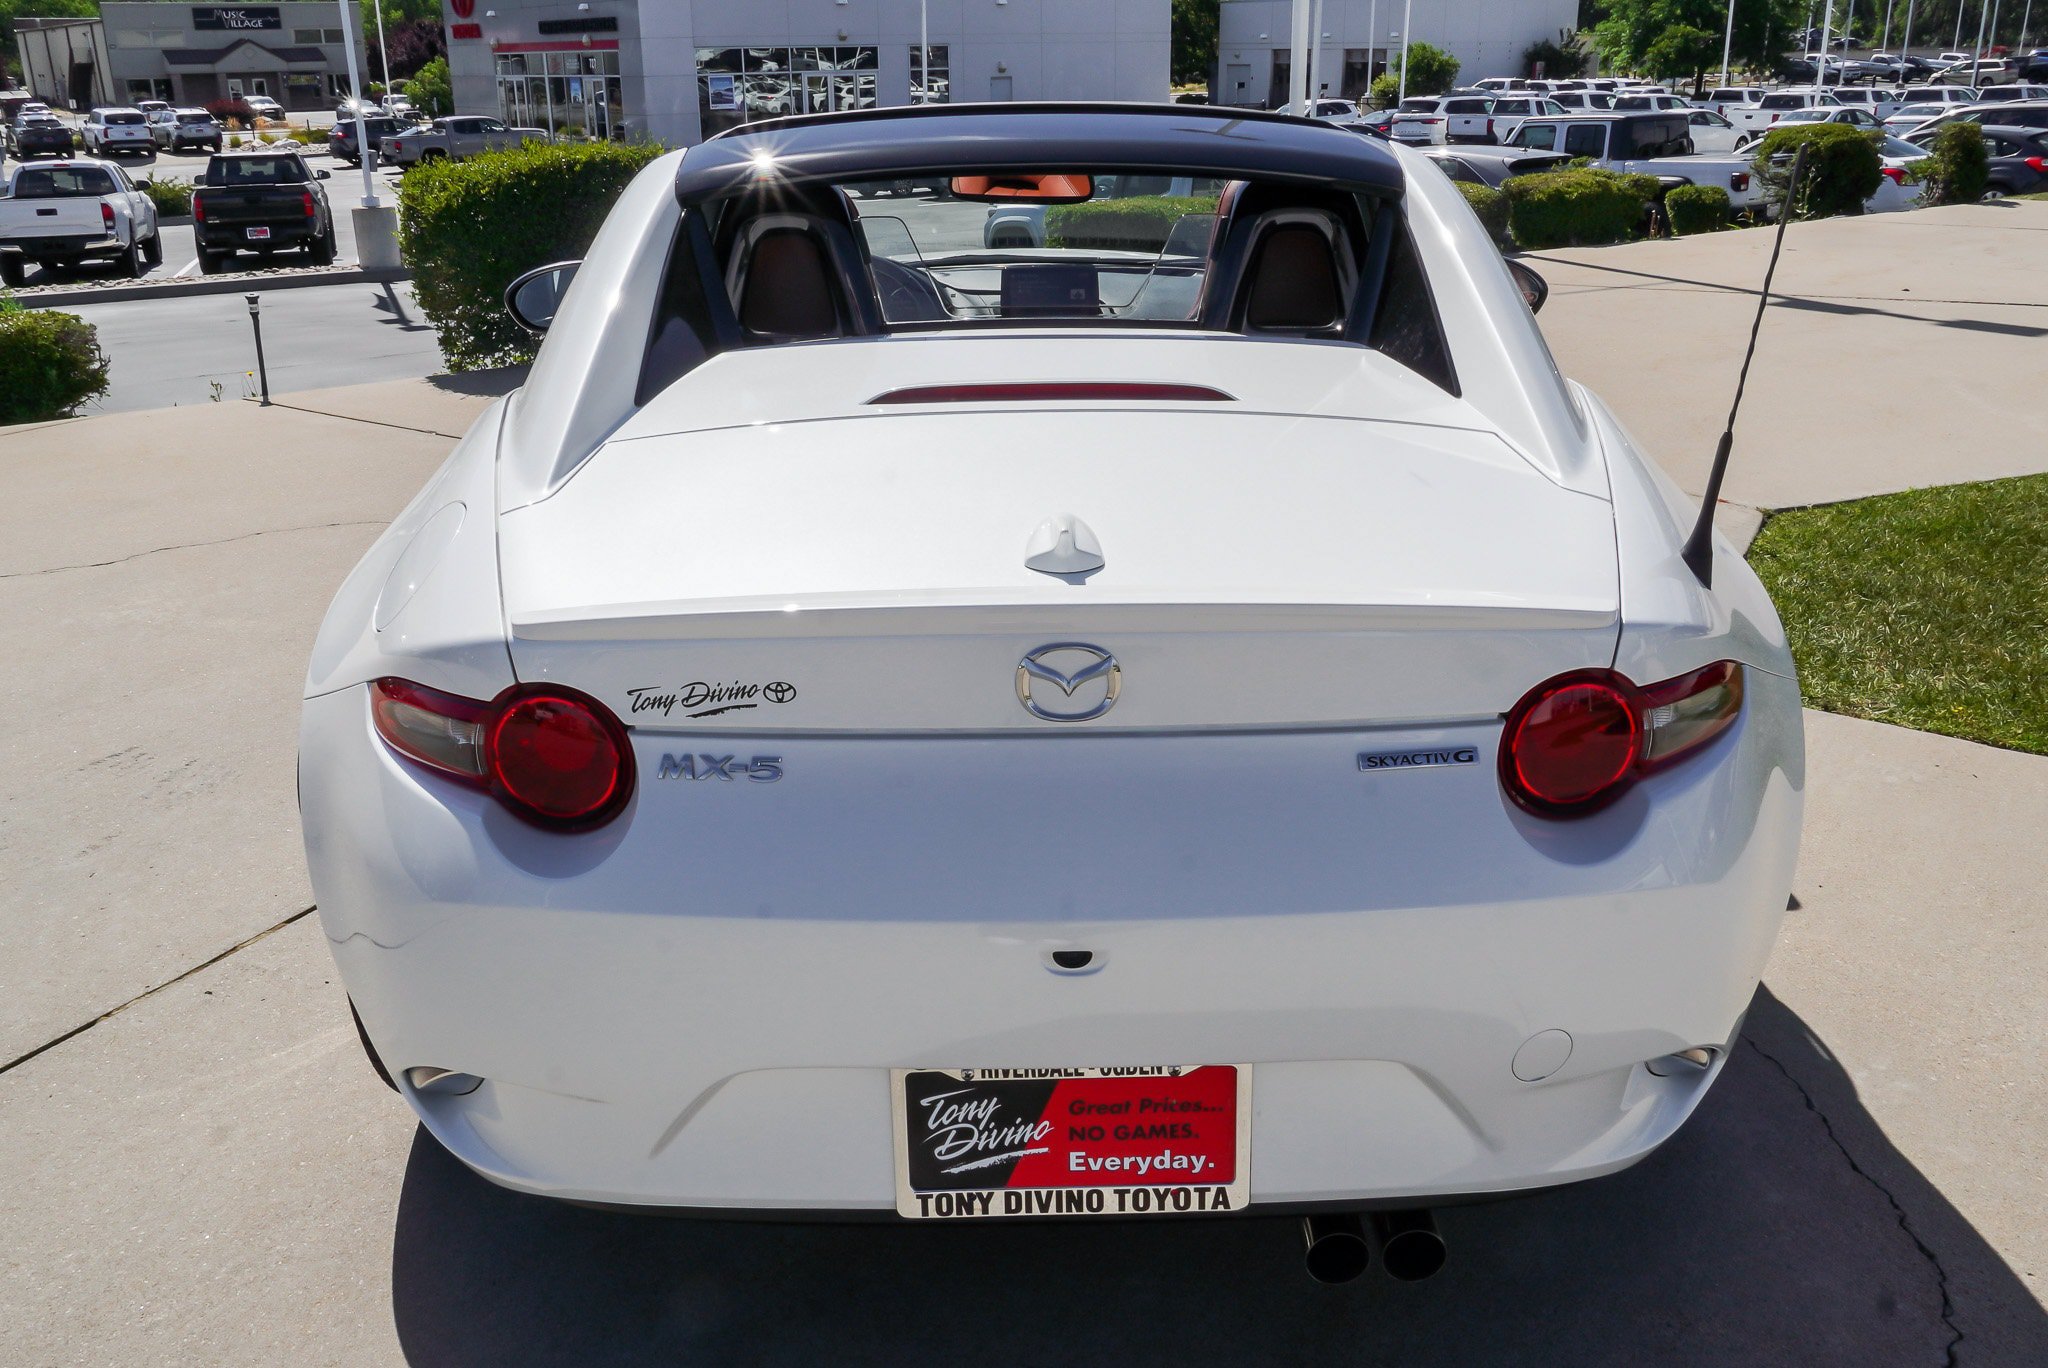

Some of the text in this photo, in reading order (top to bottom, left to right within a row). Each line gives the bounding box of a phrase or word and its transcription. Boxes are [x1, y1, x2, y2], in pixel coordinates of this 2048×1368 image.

[223, 19, 263, 28] VILLAGE
[627, 680, 761, 717] Tony Divino
[657, 752, 784, 783] MX-5
[920, 1088, 1002, 1131] Tony
[1068, 1099, 1133, 1116] Great
[922, 1117, 1055, 1161] Divino
[1069, 1123, 1200, 1142] NO GAMES.
[1069, 1149, 1216, 1176] Everyday.
[915, 1186, 1231, 1217] TONY DIVINO TOYOTA
